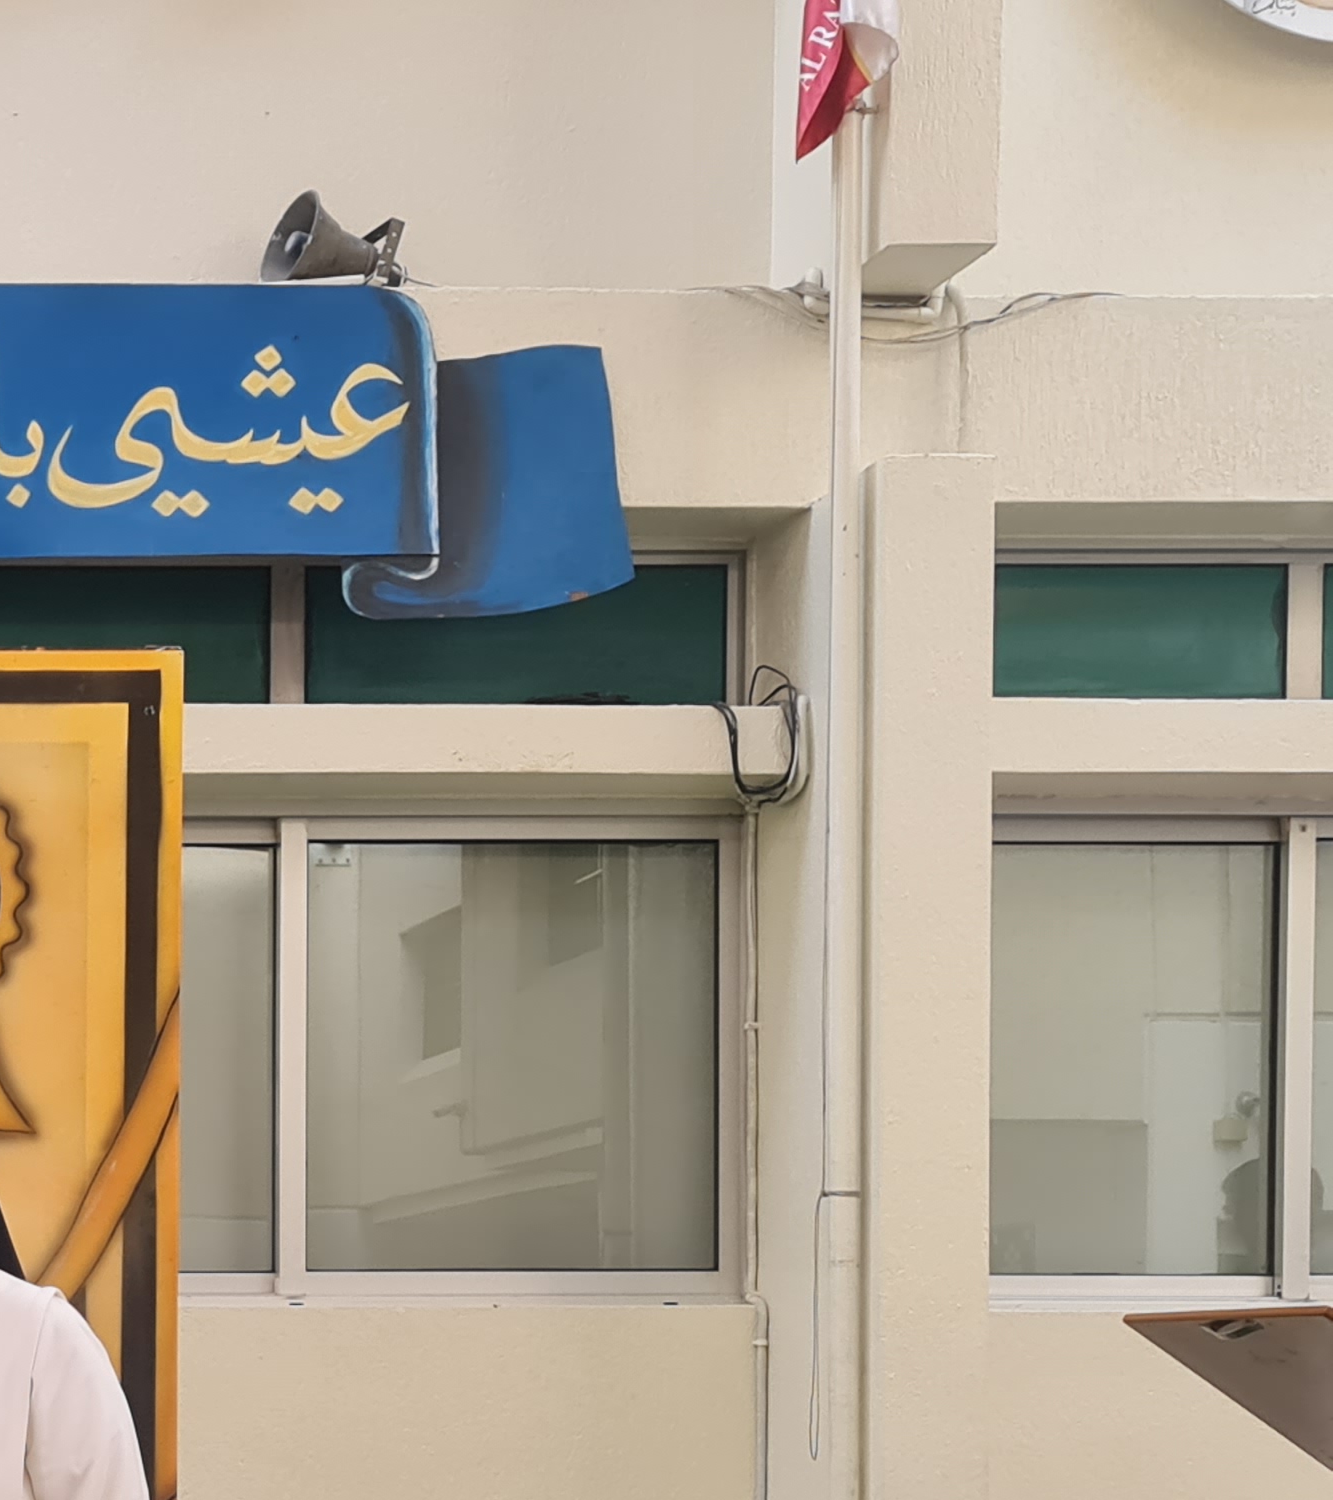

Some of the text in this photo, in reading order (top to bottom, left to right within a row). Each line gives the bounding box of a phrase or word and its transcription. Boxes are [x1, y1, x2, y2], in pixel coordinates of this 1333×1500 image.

[799, 0, 840, 92] AL RA
[48, 344, 411, 519] عيشي
